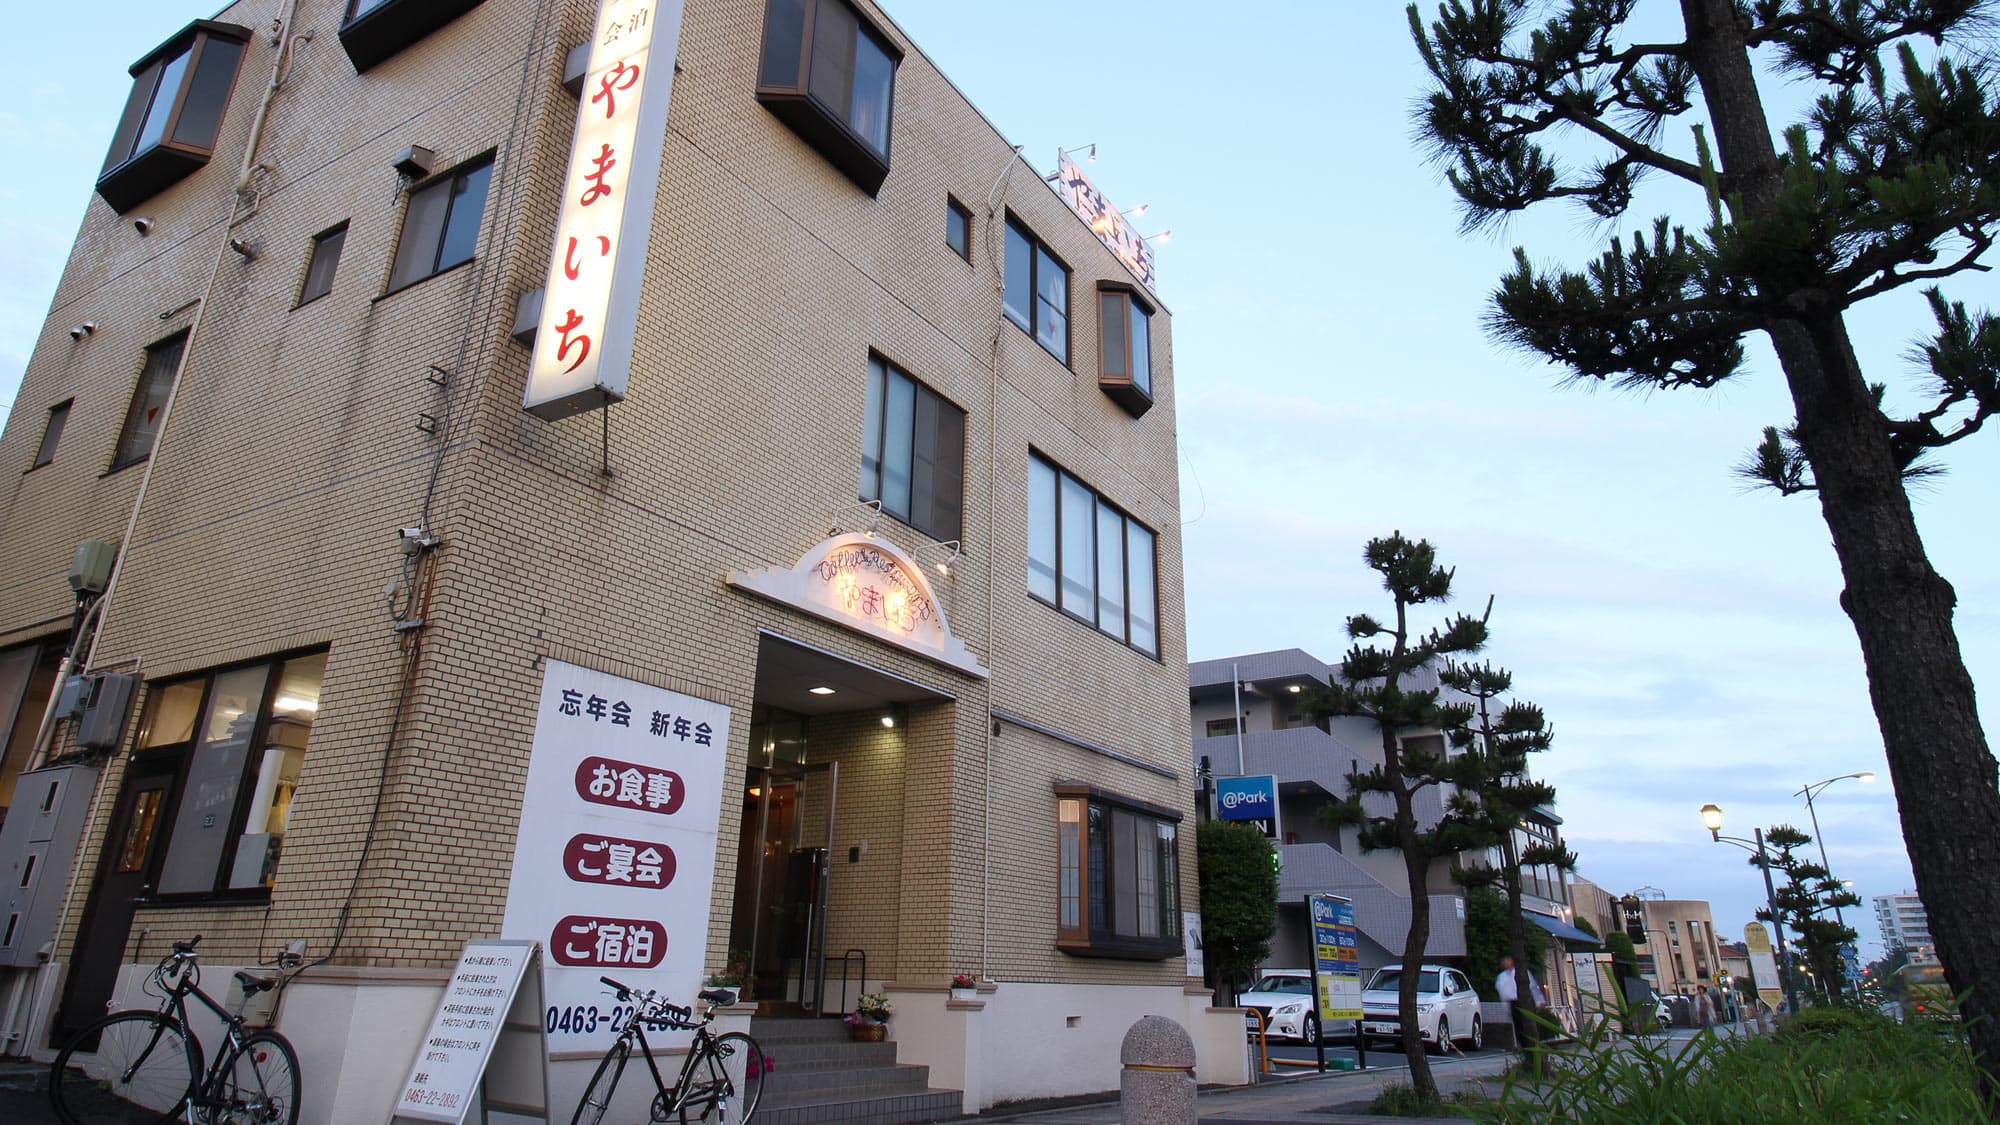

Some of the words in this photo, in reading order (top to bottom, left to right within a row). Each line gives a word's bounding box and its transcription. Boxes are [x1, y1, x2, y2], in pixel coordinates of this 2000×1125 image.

[554, 61, 640, 374] やまいち
[558, 689, 632, 728] 忘年会
[649, 710, 713, 748] 新年会
[589, 763, 674, 808] お食事
[1223, 790, 1267, 809] @Park
[577, 839, 664, 886] ご宴会
[565, 920, 655, 965] ご宿泊
